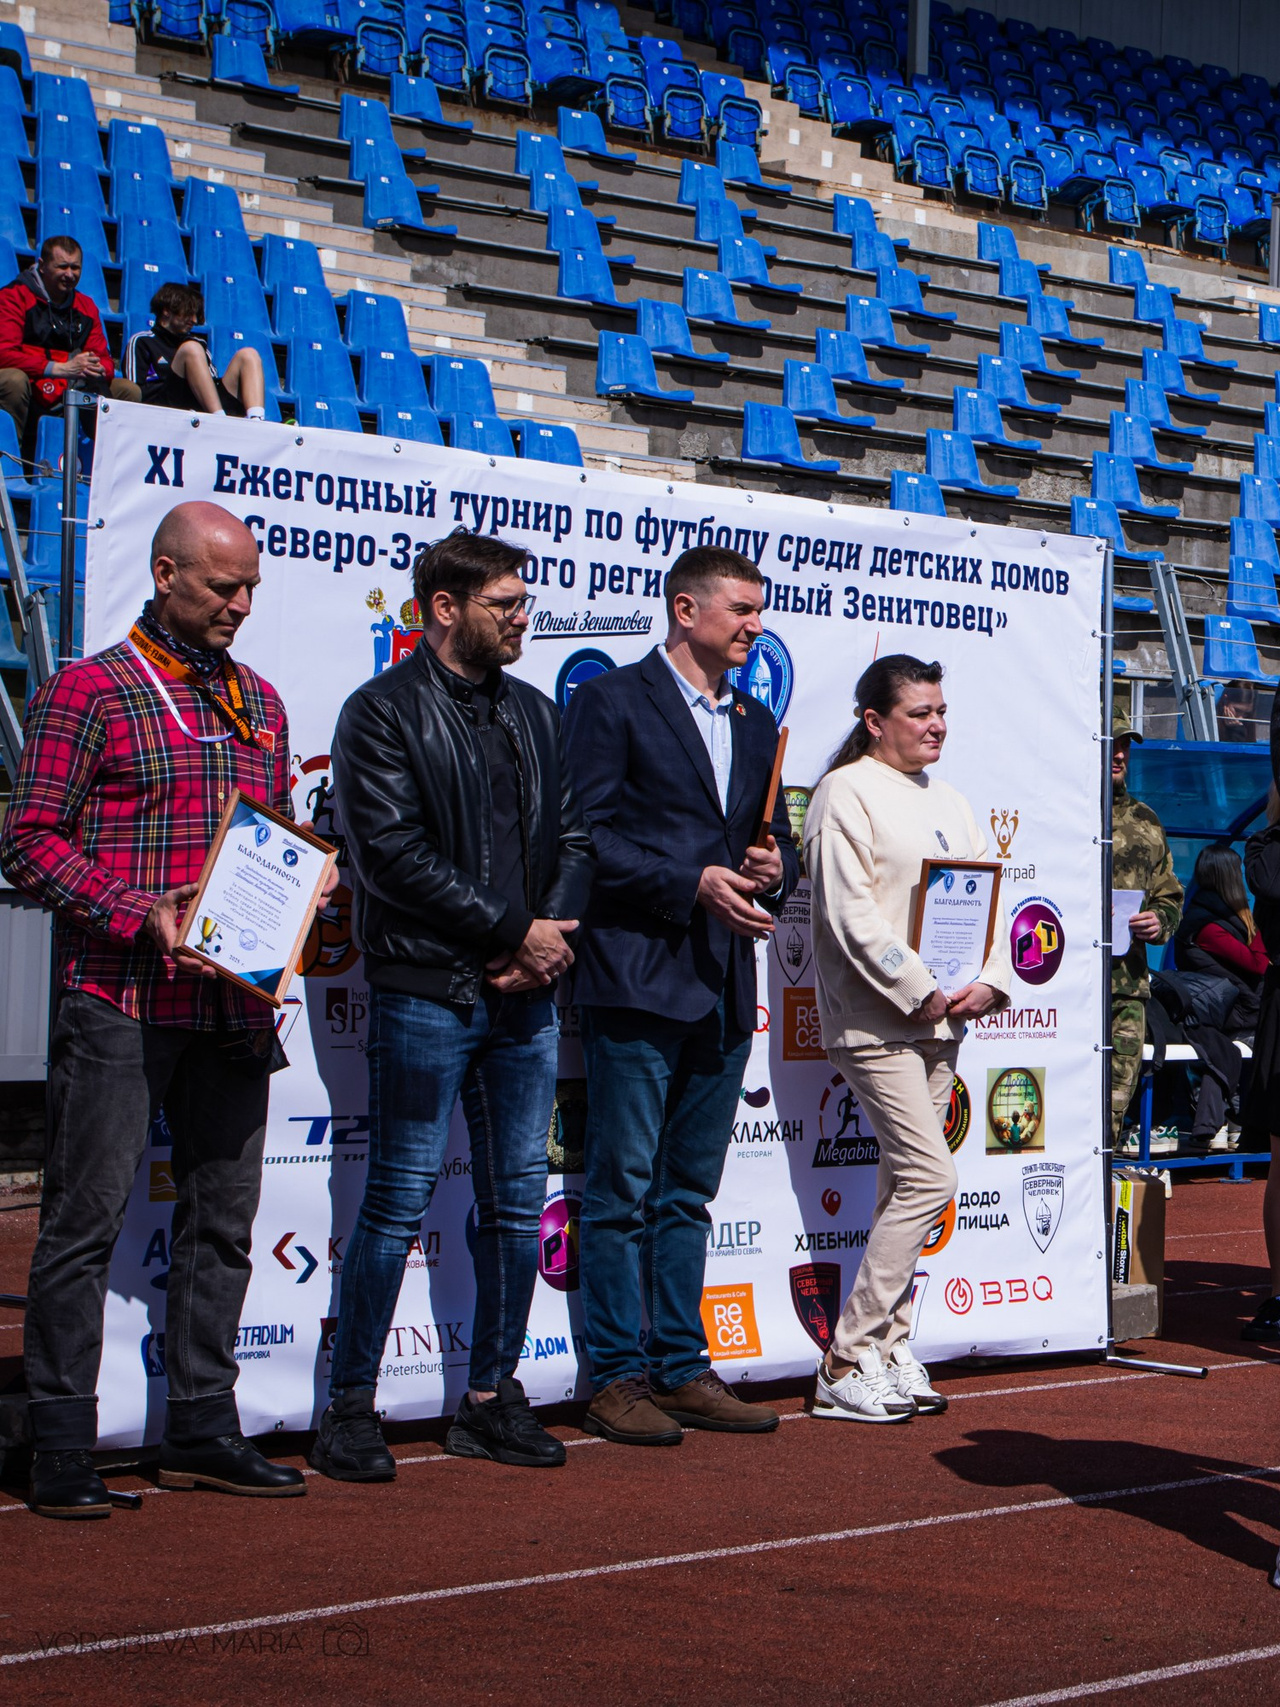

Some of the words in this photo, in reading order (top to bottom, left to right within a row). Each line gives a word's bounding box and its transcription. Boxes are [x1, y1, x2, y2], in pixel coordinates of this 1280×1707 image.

[144, 445, 185, 487] XI
[213, 453, 437, 518] Ежегодный
[450, 490, 572, 543] турнир
[584, 507, 623, 542] по
[635, 507, 769, 567] футболу
[777, 533, 863, 573] среди
[869, 545, 983, 584] детских
[991, 560, 1070, 596] домов
[532, 610, 579, 632] Юный
[582, 609, 654, 632] Зенитовец
[843, 585, 1008, 637] Зенитовец»
[237, 843, 301, 888] БЛАГОДАРНОСТЬ
[1000, 863, 1036, 883] иград
[933, 898, 982, 907] БЛАГОДАРНОСТЬ
[975, 1008, 1057, 1029] КАПИТАЛ
[975, 1031, 1017, 1040] МЕДИЦИНСКОЕ
[1018, 1031, 1057, 1039] СТРАХОВАНИЕ
[729, 1119, 803, 1144] КЛАЖАН
[737, 1150, 773, 1159] РЕСТОРАН
[818, 1142, 880, 1165] Megabitu
[1021, 1162, 1066, 1176] САНКТ-ПЕТЕРБУРГ
[1024, 1178, 1062, 1190] СЕВЕРНЫЙ
[1027, 1189, 1060, 1197] ЧЕЛОВЕК
[958, 1191, 1001, 1210] ДОДО
[958, 1213, 1010, 1231] ПИЦЦА
[705, 1221, 762, 1250] ИДЕР
[794, 1229, 871, 1252] ХЛЕБНИК
[715, 1248, 742, 1257] КРАЙНЕГО
[743, 1247, 763, 1256] СЕВЕРА
[705, 1292, 732, 1300] Restaurants
[736, 1290, 747, 1298] Cafe
[980, 1275, 1053, 1306] BBQ
[234, 1351, 271, 1362] КИПИРОВКА
[534, 1336, 569, 1361] ДОМ
[378, 1360, 445, 1378] t-Petersburg
